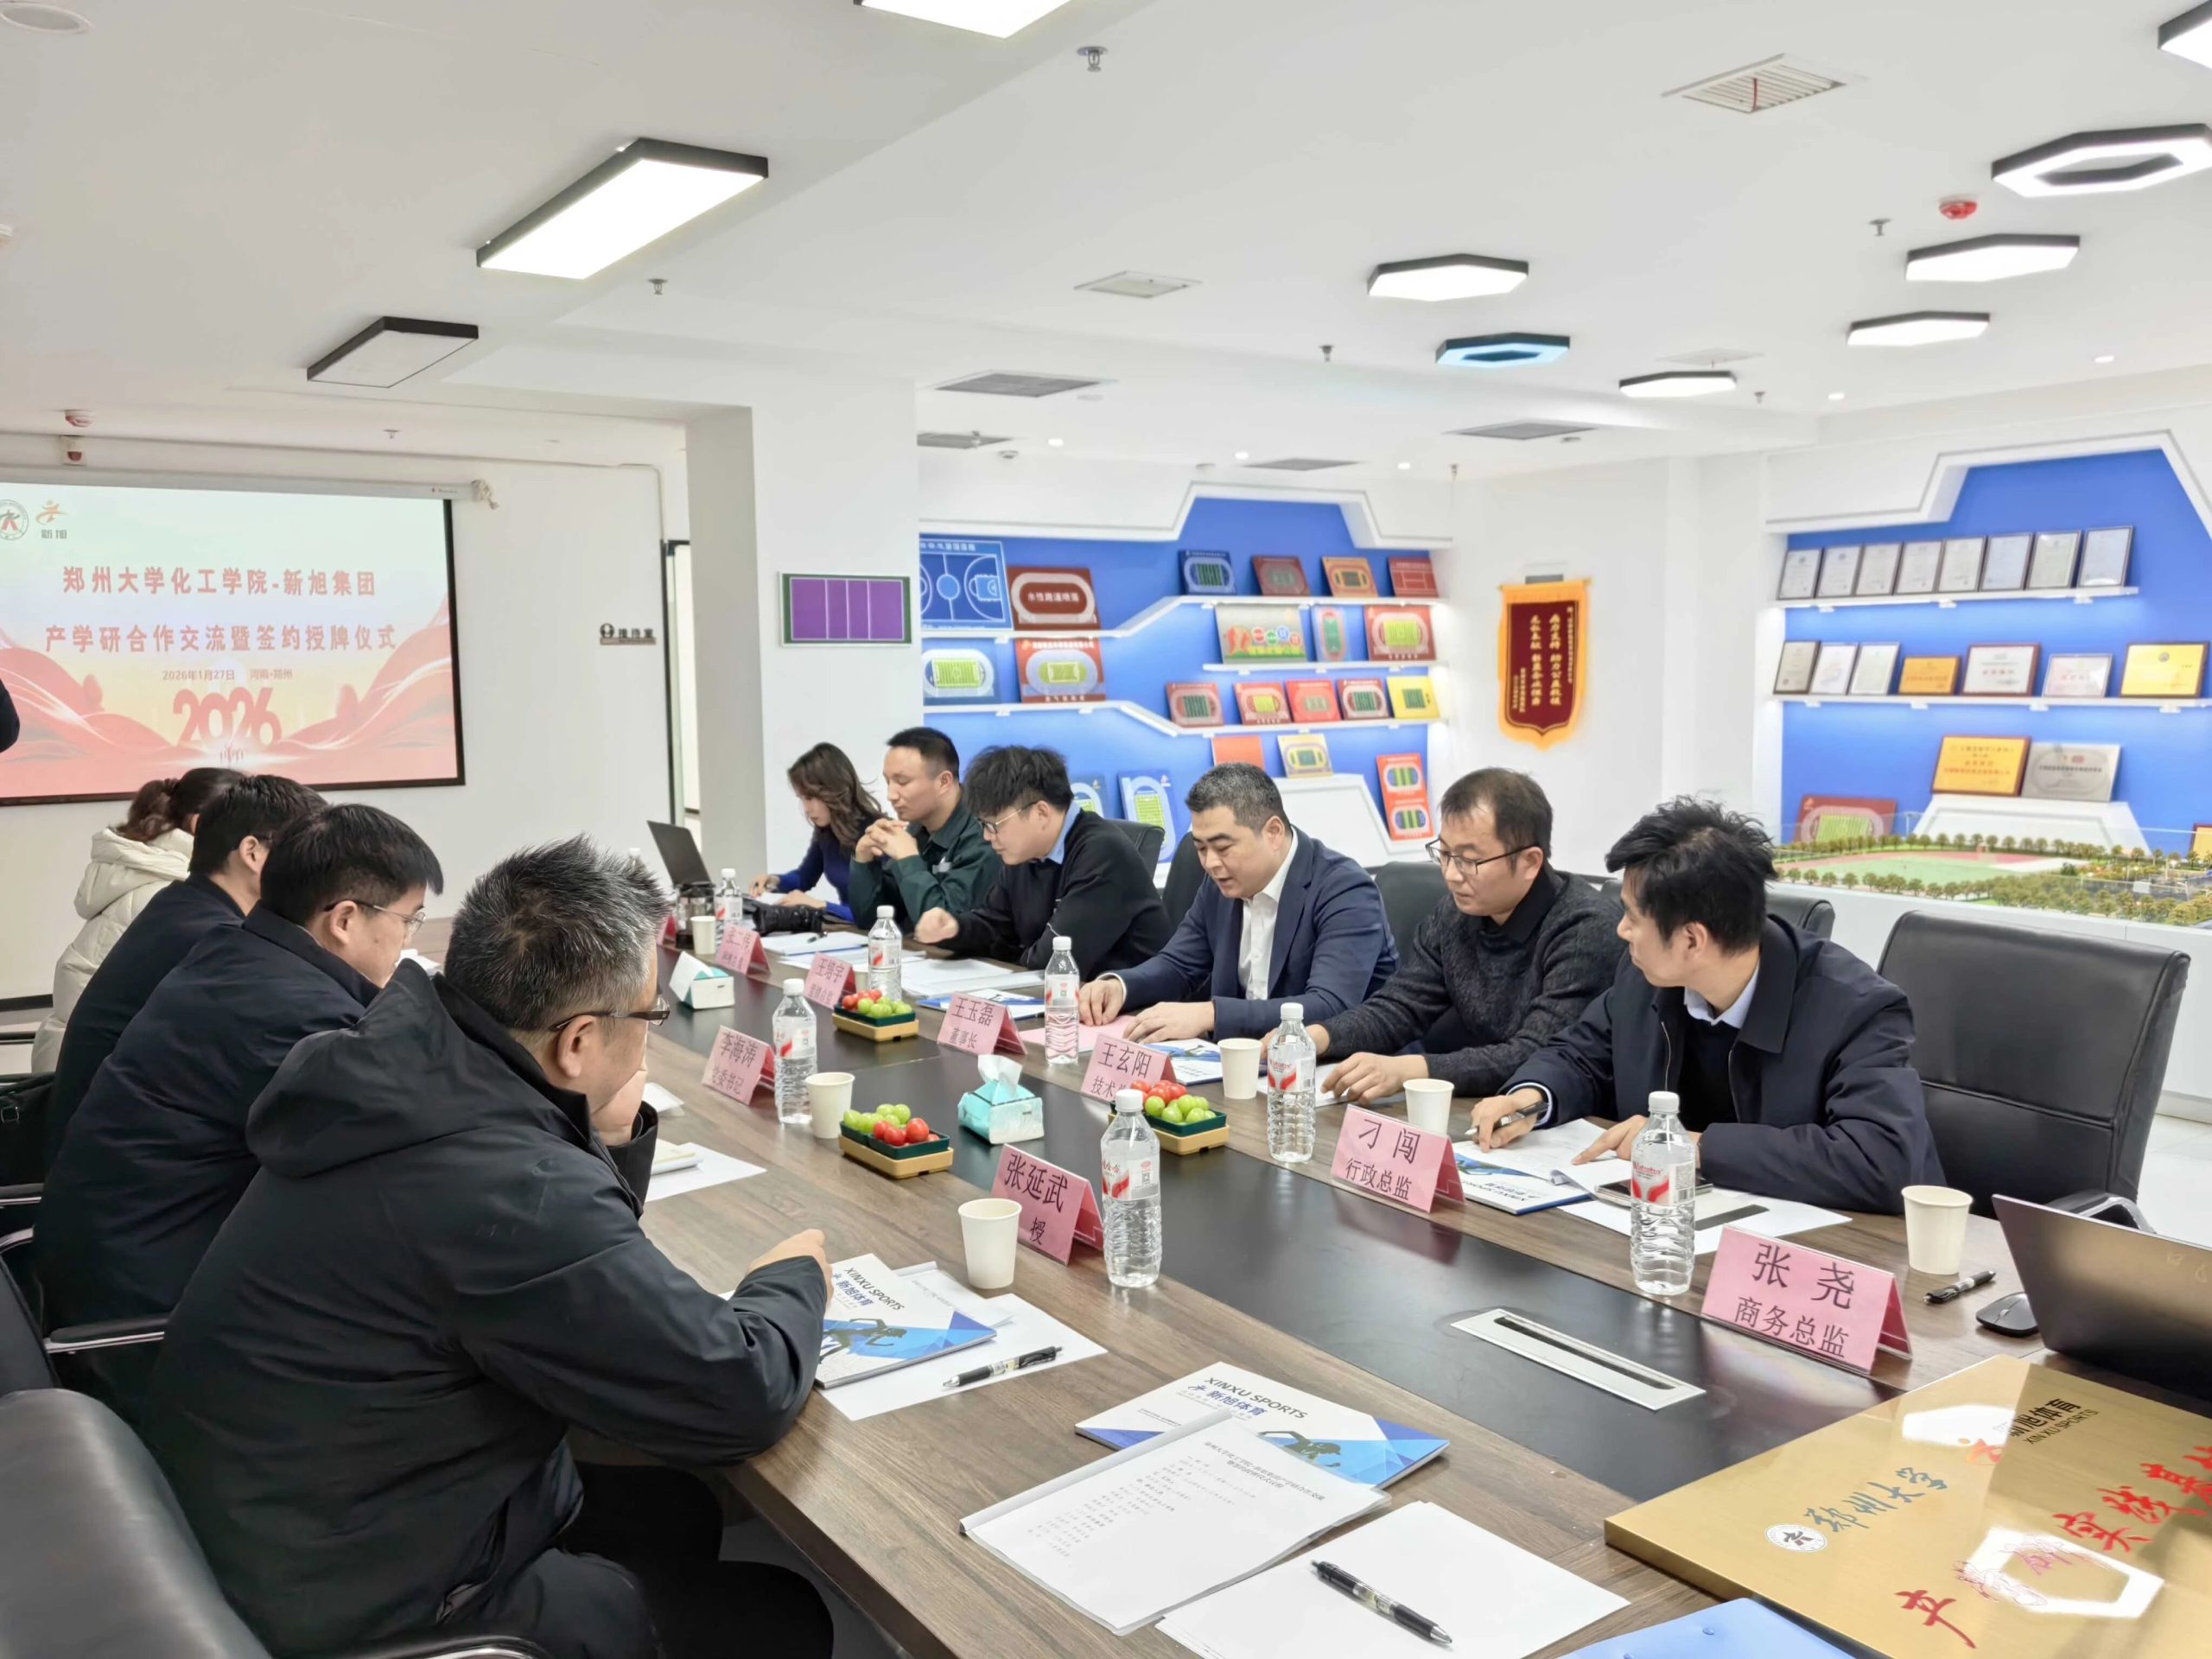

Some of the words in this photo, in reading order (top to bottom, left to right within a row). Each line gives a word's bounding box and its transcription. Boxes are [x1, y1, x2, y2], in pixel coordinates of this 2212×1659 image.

[62, 566, 376, 596] 郑州大学化工学院-新旭集团
[45, 624, 397, 653] 产学研合作交流暨签约授牌仪式
[162, 669, 235, 681] 2026年1月27日
[173, 686, 283, 747] 2026
[951, 996, 995, 1027] 王玉磊
[719, 1031, 758, 1068] 李海涛
[949, 1027, 977, 1049] 董事长
[1097, 1042, 1152, 1078] 王玄阳
[712, 1065, 744, 1095] 党委书记
[1357, 1118, 1421, 1165] 刁闯
[1003, 1153, 1068, 1213] 张延武
[1344, 1156, 1413, 1201] 行政总监
[836, 1280, 875, 1306] 新旭体育
[843, 1267, 874, 1290] XINXU
[868, 1288, 906, 1311] SPORTS
[1751, 1243, 1856, 1311] 张尧
[1732, 1295, 1850, 1359] 商务总监
[1204, 1377, 1252, 1397] XINXU
[1249, 1395, 1309, 1419] SPORTS
[1206, 1389, 1268, 1416] 新旭体育
[2023, 1433, 2047, 1445] XIN
[2041, 1426, 2061, 1436] XU
[2055, 1408, 2100, 1428] SPORTS
[1803, 1466, 1948, 1533] 郑州大学
